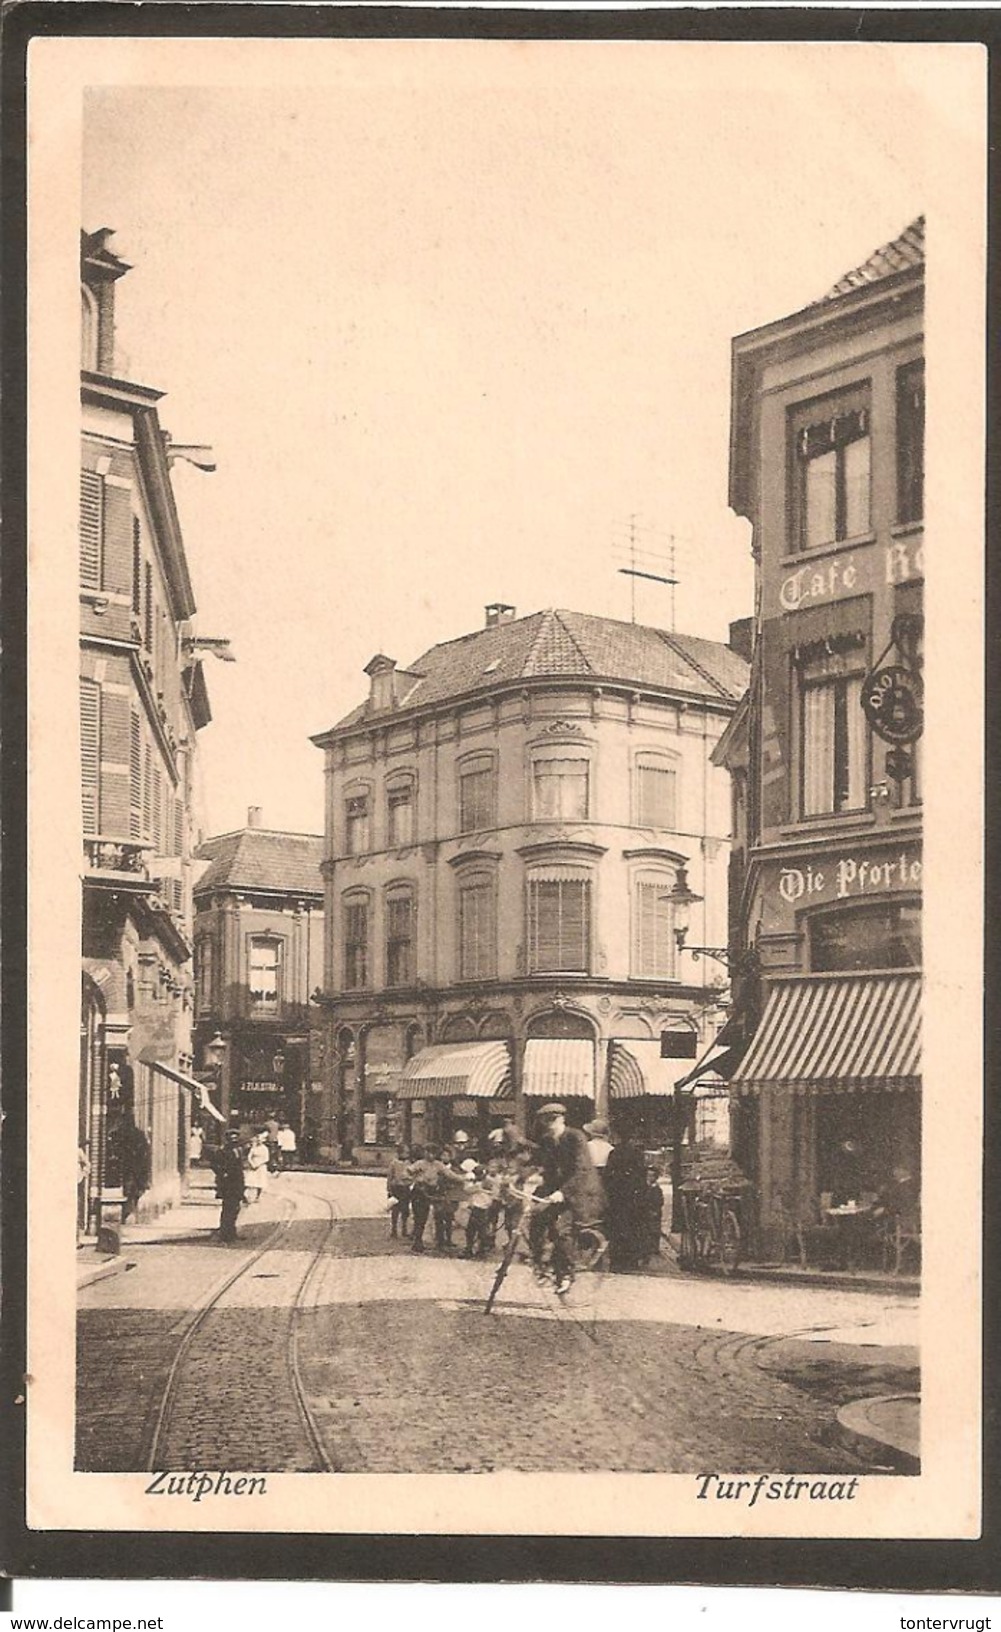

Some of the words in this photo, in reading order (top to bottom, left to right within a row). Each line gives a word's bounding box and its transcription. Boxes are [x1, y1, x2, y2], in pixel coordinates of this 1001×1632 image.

[779, 555, 857, 610] Café
[869, 673, 893, 710] OXO
[779, 865, 825, 903] Die
[836, 853, 922, 899] Pforte
[144, 1471, 268, 1502] Zutphen
[695, 1473, 860, 1508] Turfstraat
